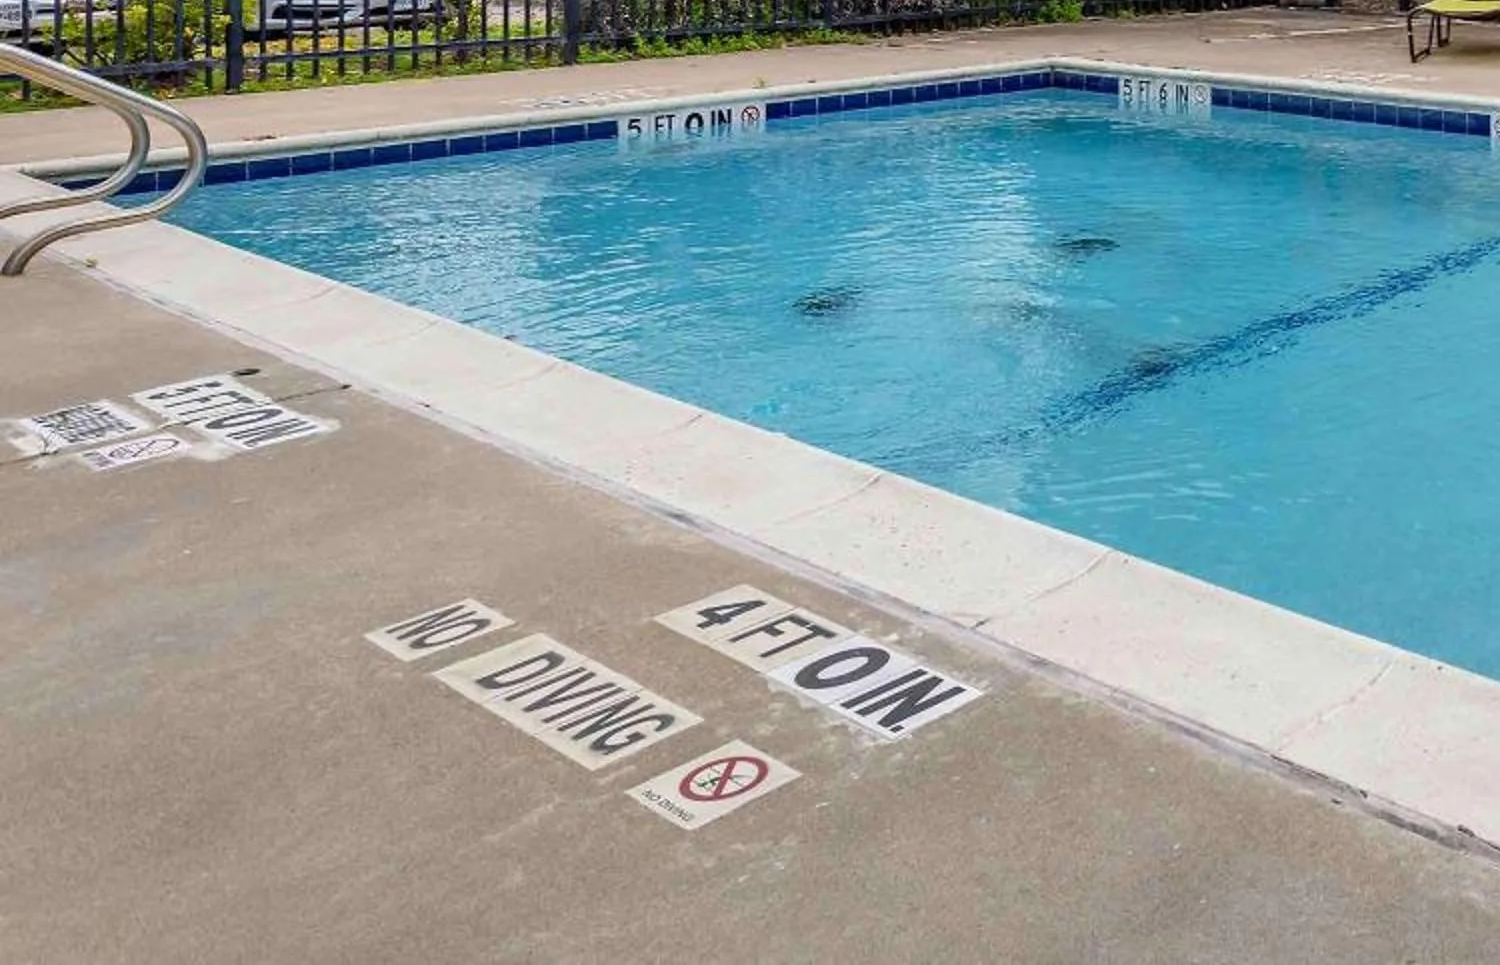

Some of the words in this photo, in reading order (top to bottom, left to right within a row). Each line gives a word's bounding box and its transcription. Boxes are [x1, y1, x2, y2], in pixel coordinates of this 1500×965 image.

[1123, 78, 1133, 96] 5
[1175, 84, 1189, 103] IN
[627, 118, 642, 137] 5
[655, 114, 676, 133] FT
[711, 108, 732, 127] IN
[164, 390, 255, 416] FT
[696, 599, 767, 630] 4
[729, 613, 838, 658] FT
[385, 605, 491, 649] NO
[475, 650, 675, 756] DIVING
